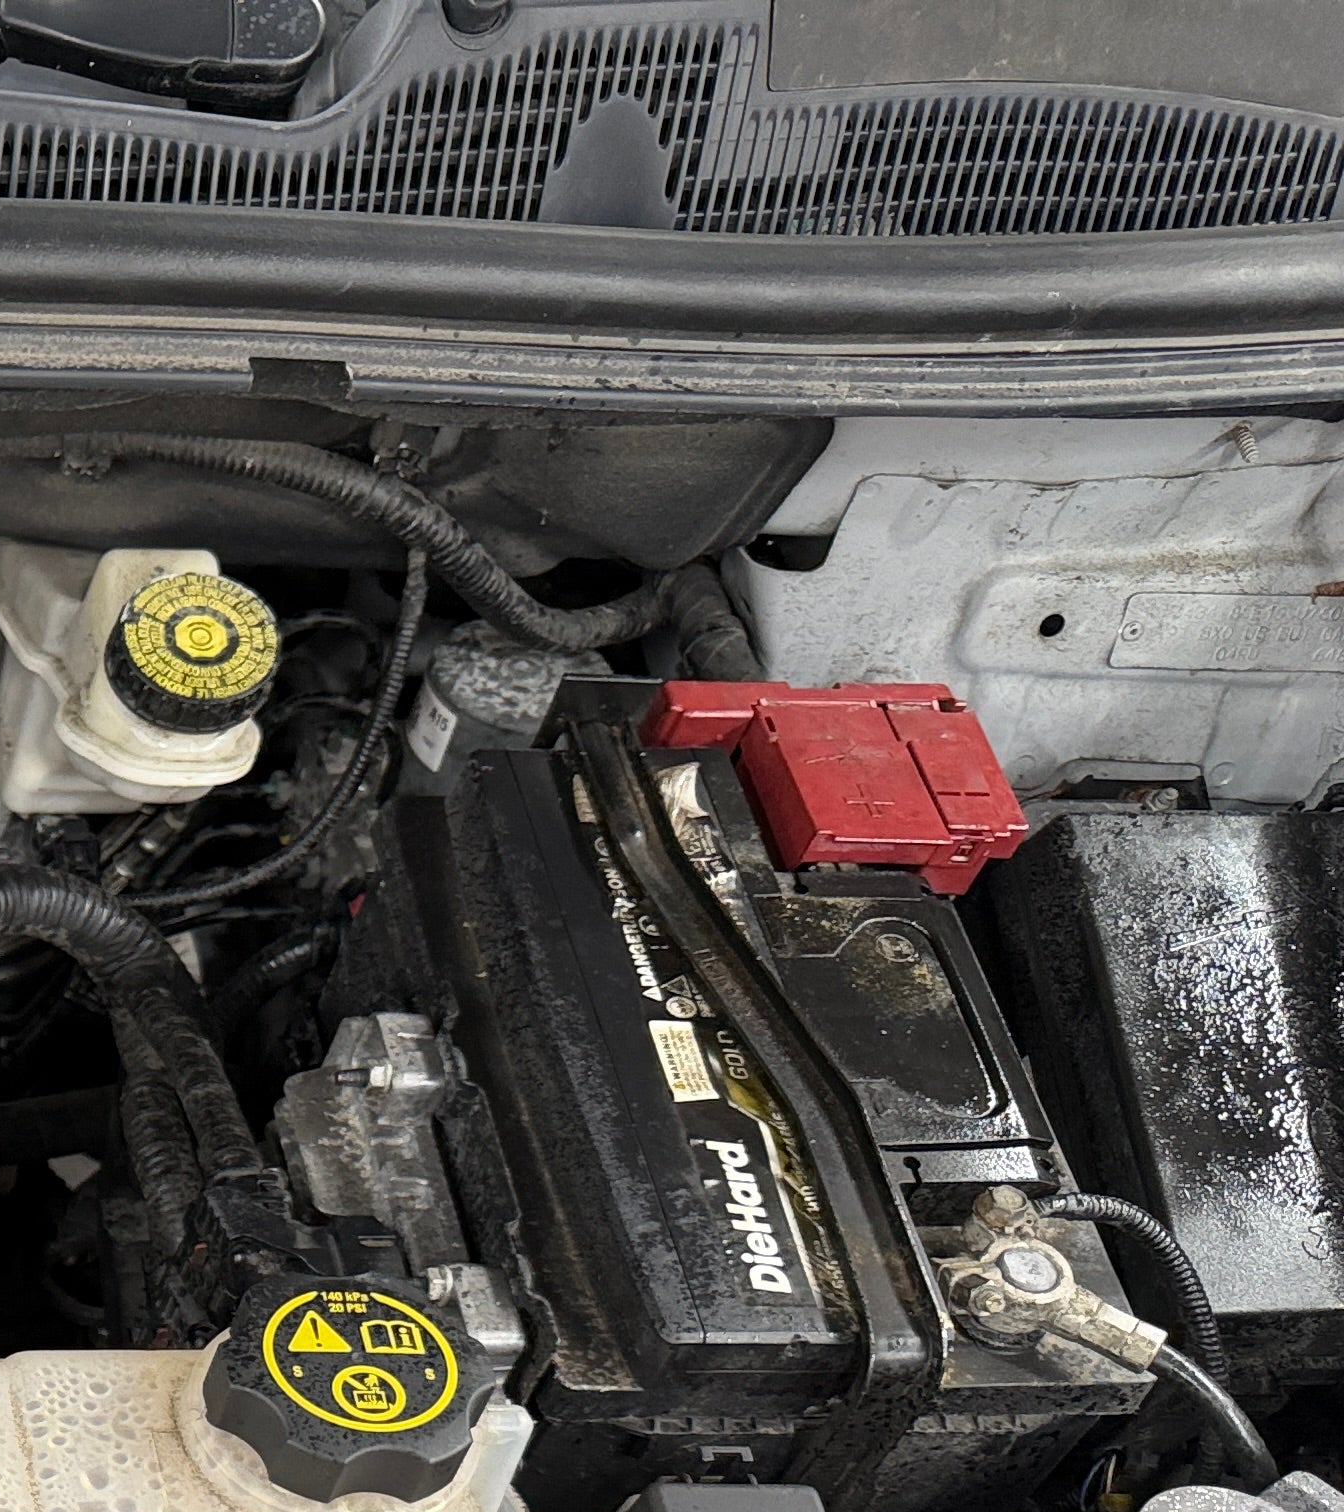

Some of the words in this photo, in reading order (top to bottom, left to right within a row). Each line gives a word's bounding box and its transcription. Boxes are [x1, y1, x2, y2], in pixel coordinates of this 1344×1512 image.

[706, 1140, 792, 1294] DieHard
[320, 1291, 343, 1303] 140
[345, 1291, 370, 1303] kPa
[328, 1302, 344, 1314] 20
[346, 1302, 367, 1314] PSI
